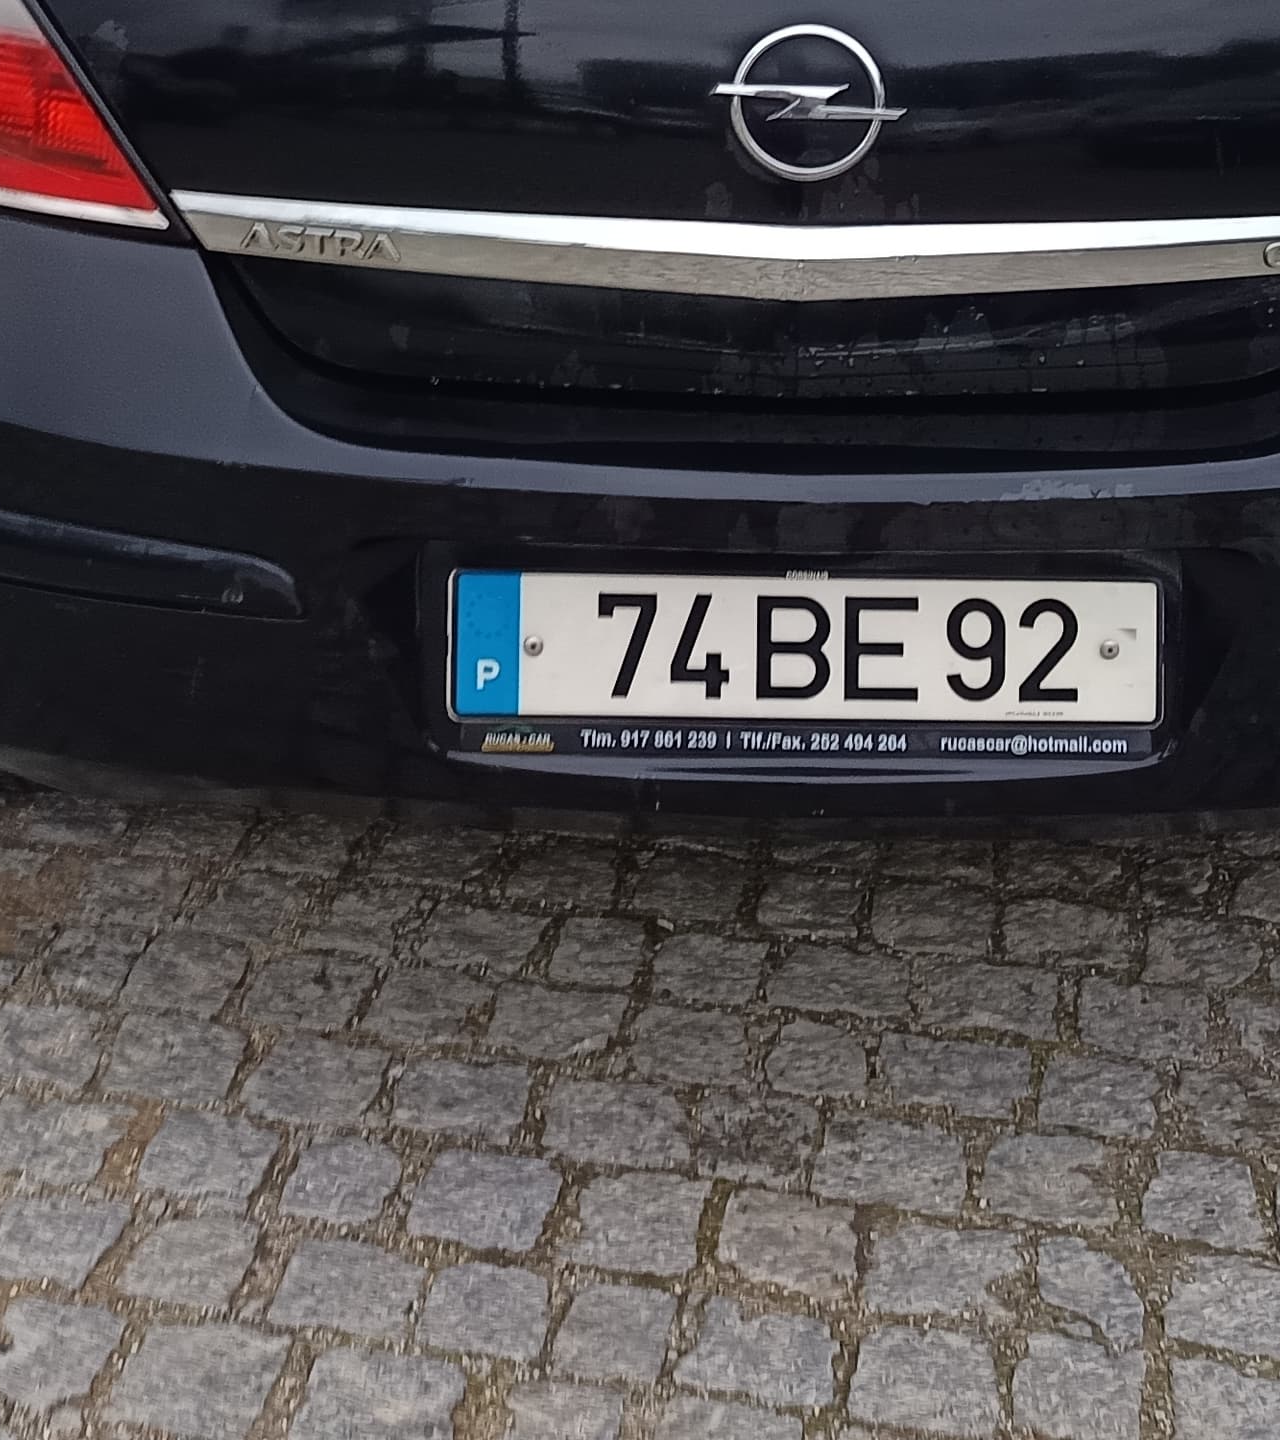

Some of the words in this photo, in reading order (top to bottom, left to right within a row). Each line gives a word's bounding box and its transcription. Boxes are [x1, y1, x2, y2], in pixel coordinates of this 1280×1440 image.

[240, 222, 401, 262] ASTRA
[597, 593, 729, 701] 74
[756, 596, 920, 701] BE
[945, 598, 1080, 702] 92
[475, 658, 501, 691] P
[620, 729, 650, 748] 917
[687, 730, 718, 749] 239
[843, 733, 874, 753] 494
[940, 734, 1128, 756] rucascar@hotmail.com
